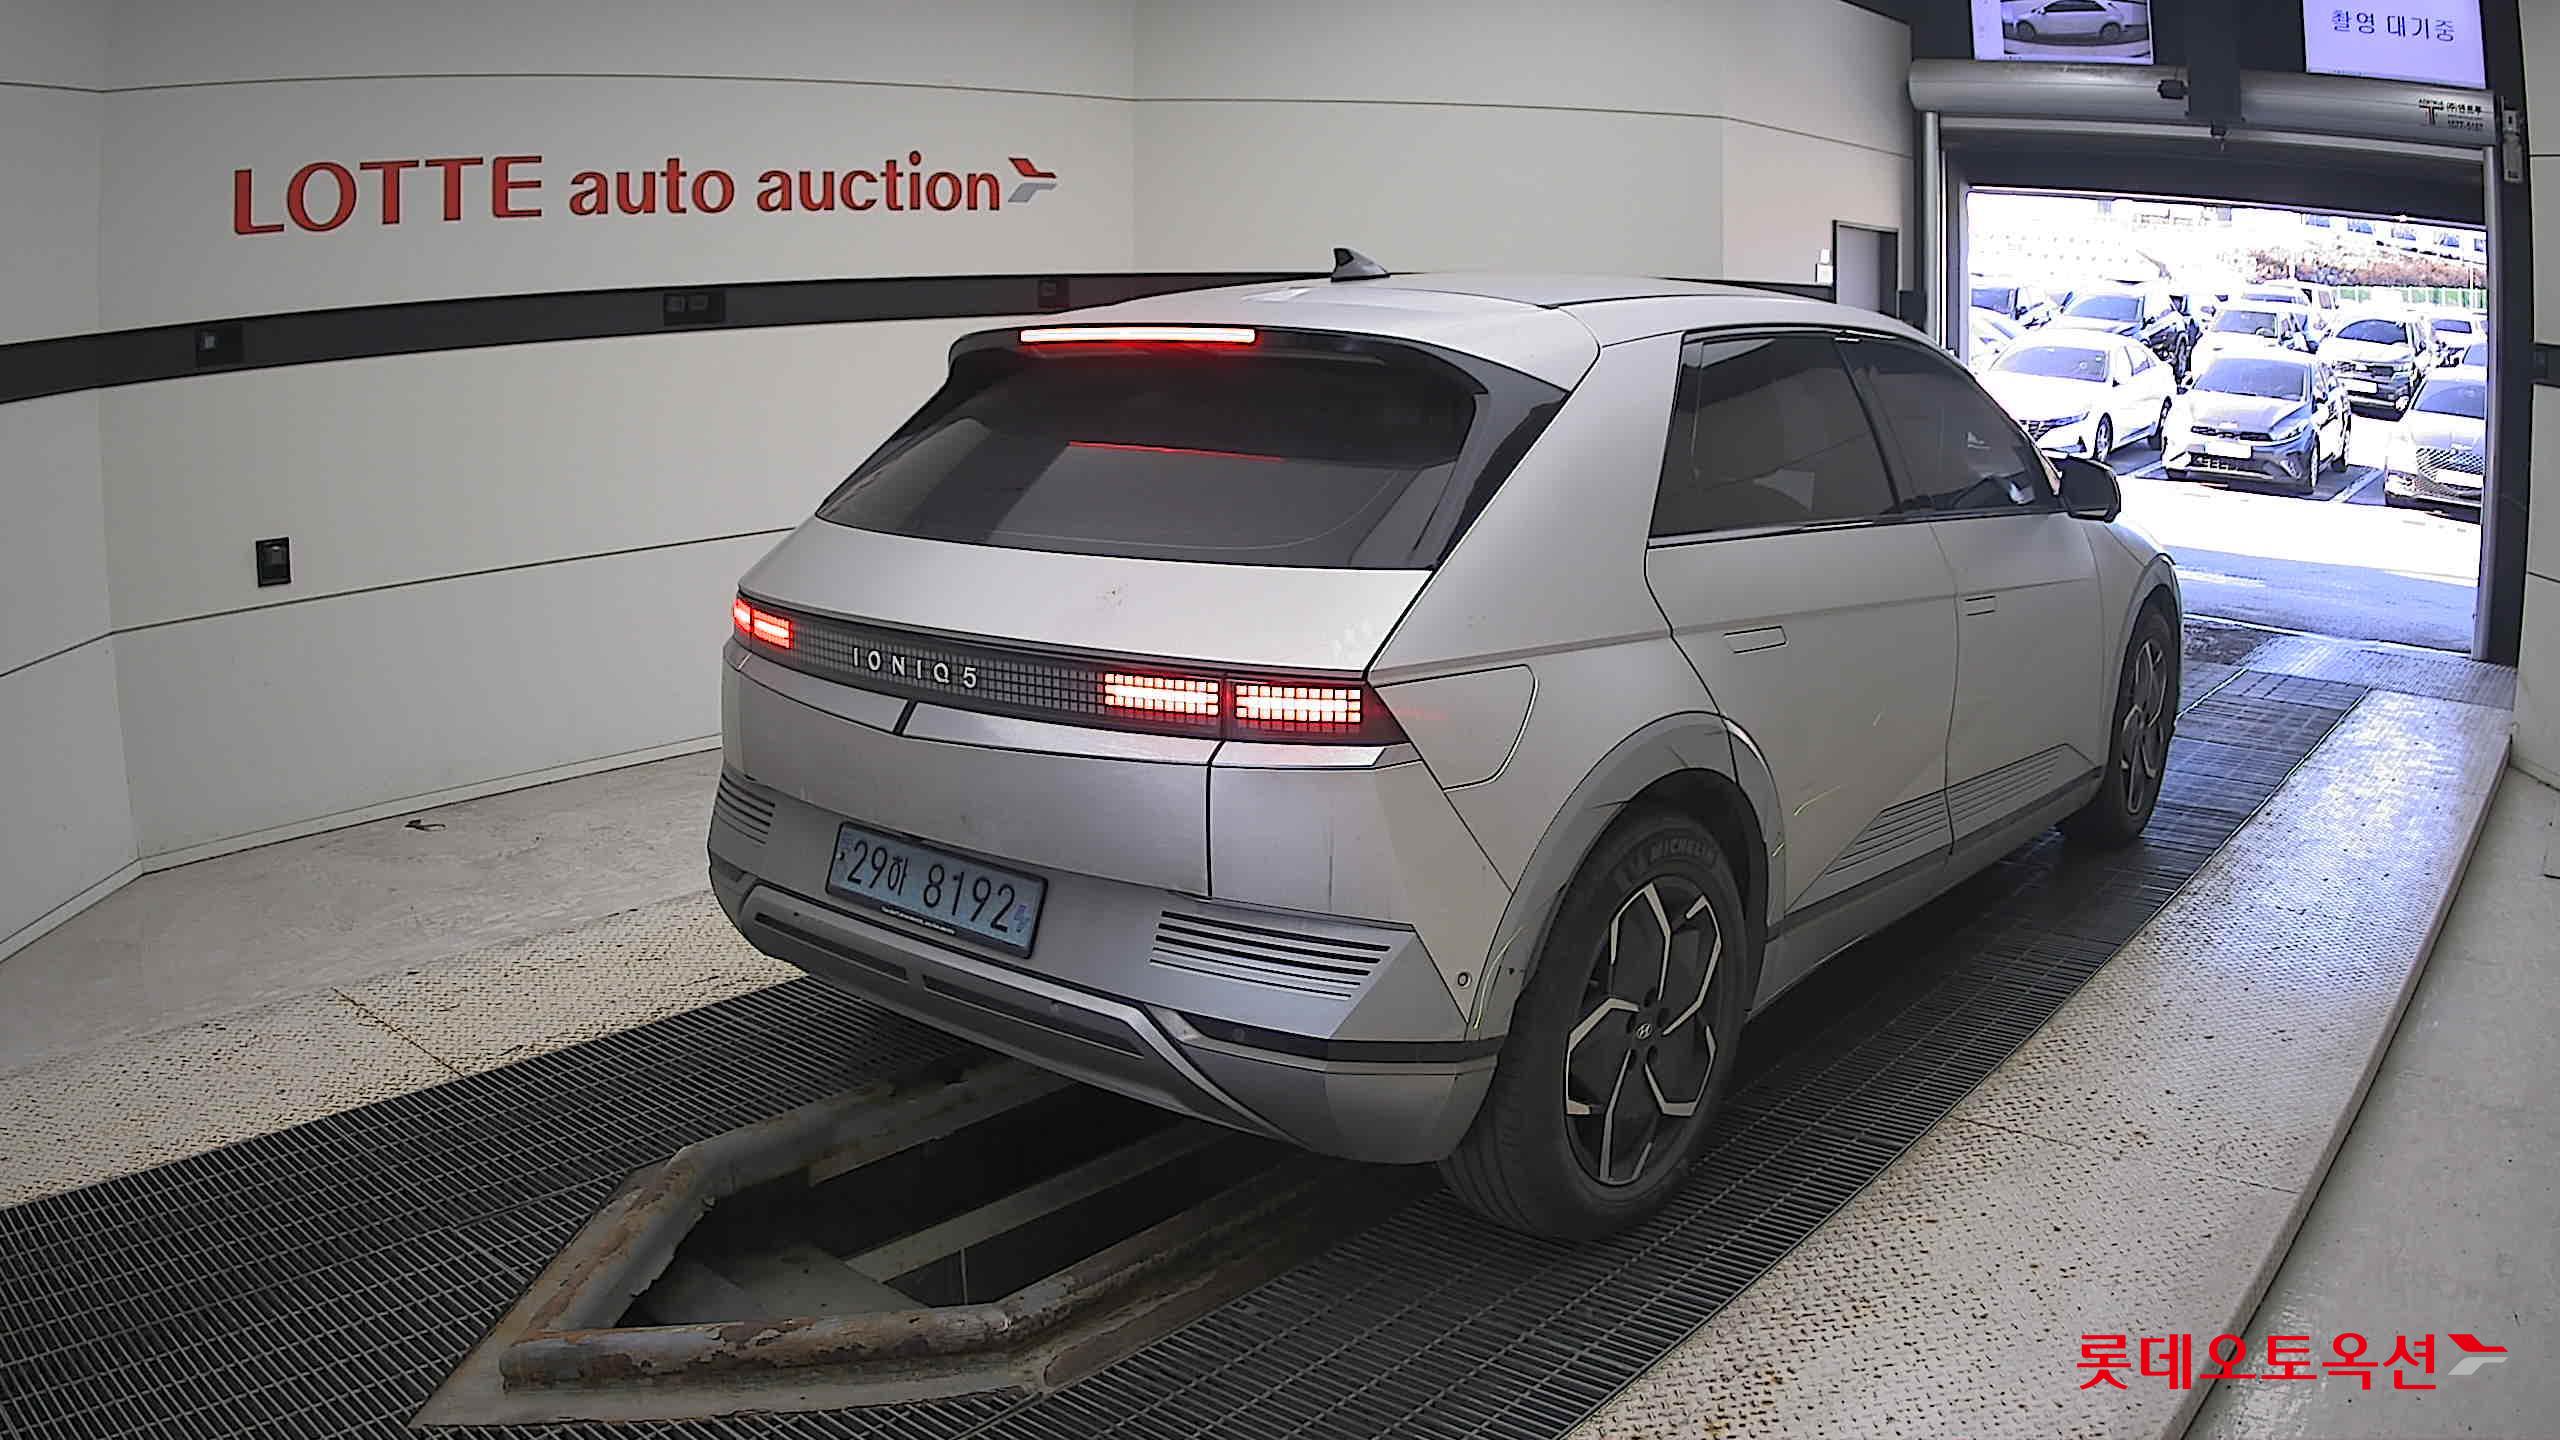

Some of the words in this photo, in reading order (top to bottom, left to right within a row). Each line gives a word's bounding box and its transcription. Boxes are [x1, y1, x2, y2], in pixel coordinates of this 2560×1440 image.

[2331, 9, 2376, 34] 촬영
[2387, 15, 2455, 42] 대기중
[234, 155, 543, 235] LOTTE
[568, 156, 736, 216] auto
[756, 150, 1002, 212] auction
[851, 646, 951, 685] IONIQ
[962, 666, 978, 689] 5
[847, 839, 909, 897] 29하
[922, 863, 1016, 933] 8192
